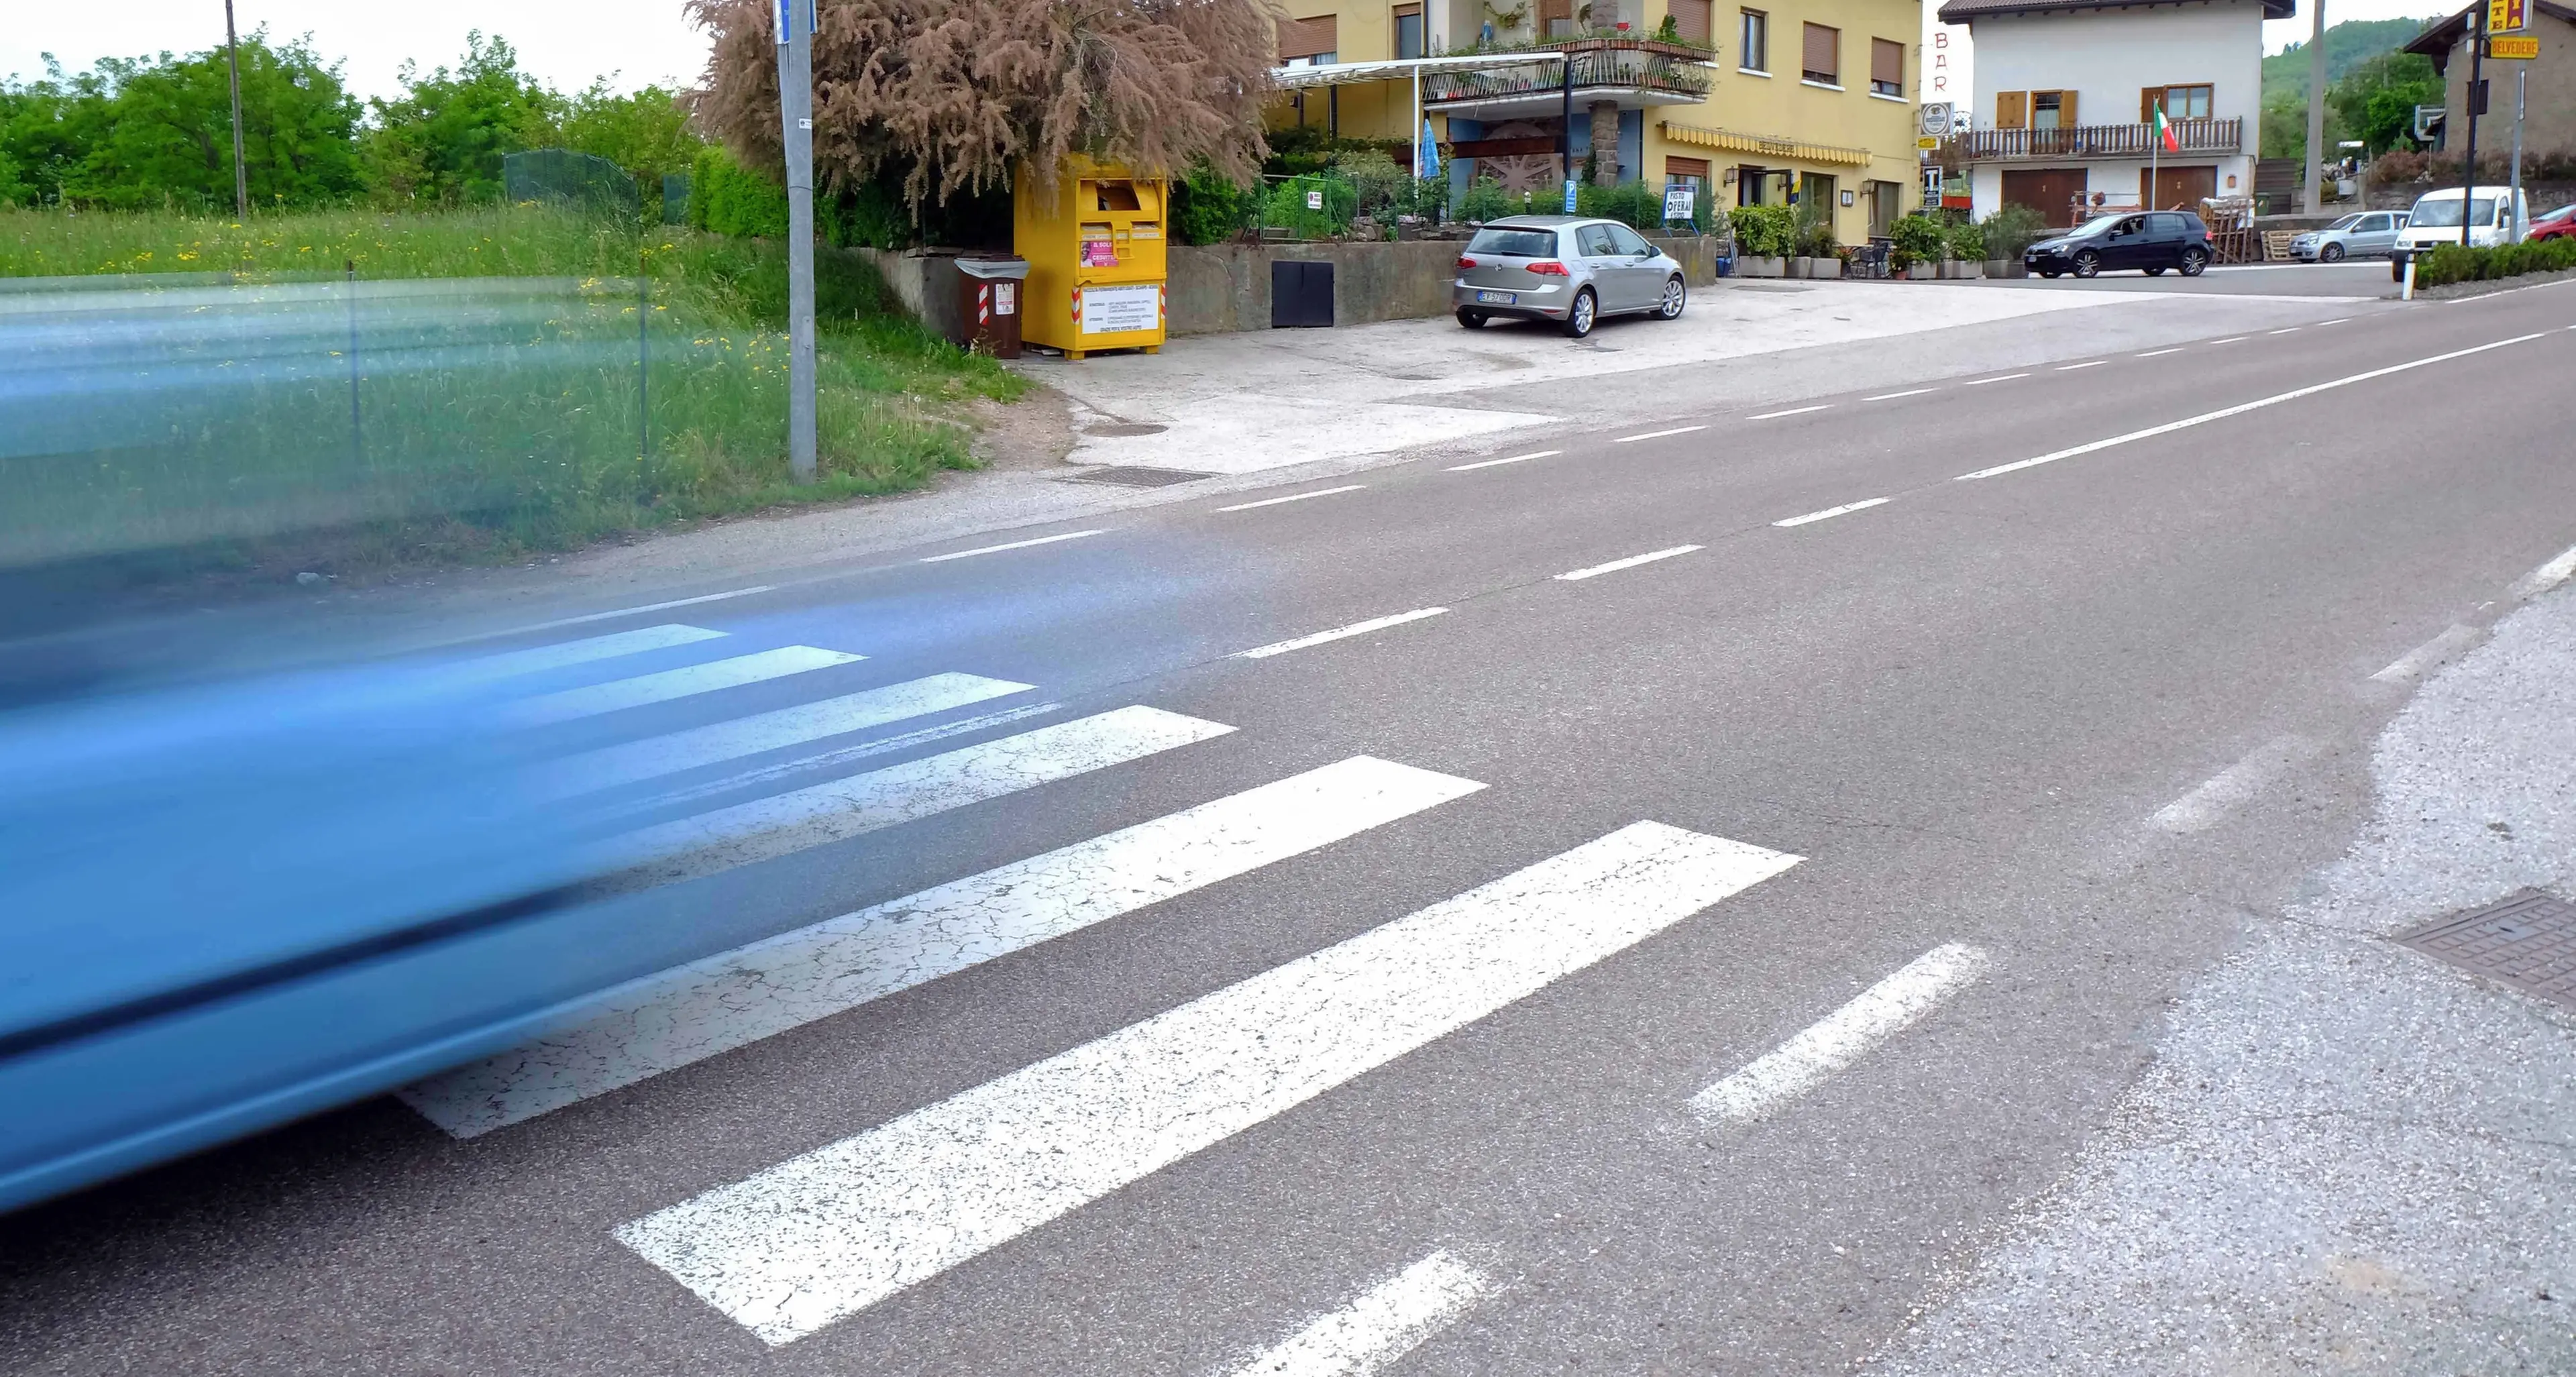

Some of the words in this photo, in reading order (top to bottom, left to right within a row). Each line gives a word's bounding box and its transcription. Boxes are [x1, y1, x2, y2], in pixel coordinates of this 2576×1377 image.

[2493, 40, 2537, 54] BELVEDERE
[1934, 32, 1948, 92] BAR
[1569, 183, 1574, 195] P
[1925, 169, 1938, 192] T
